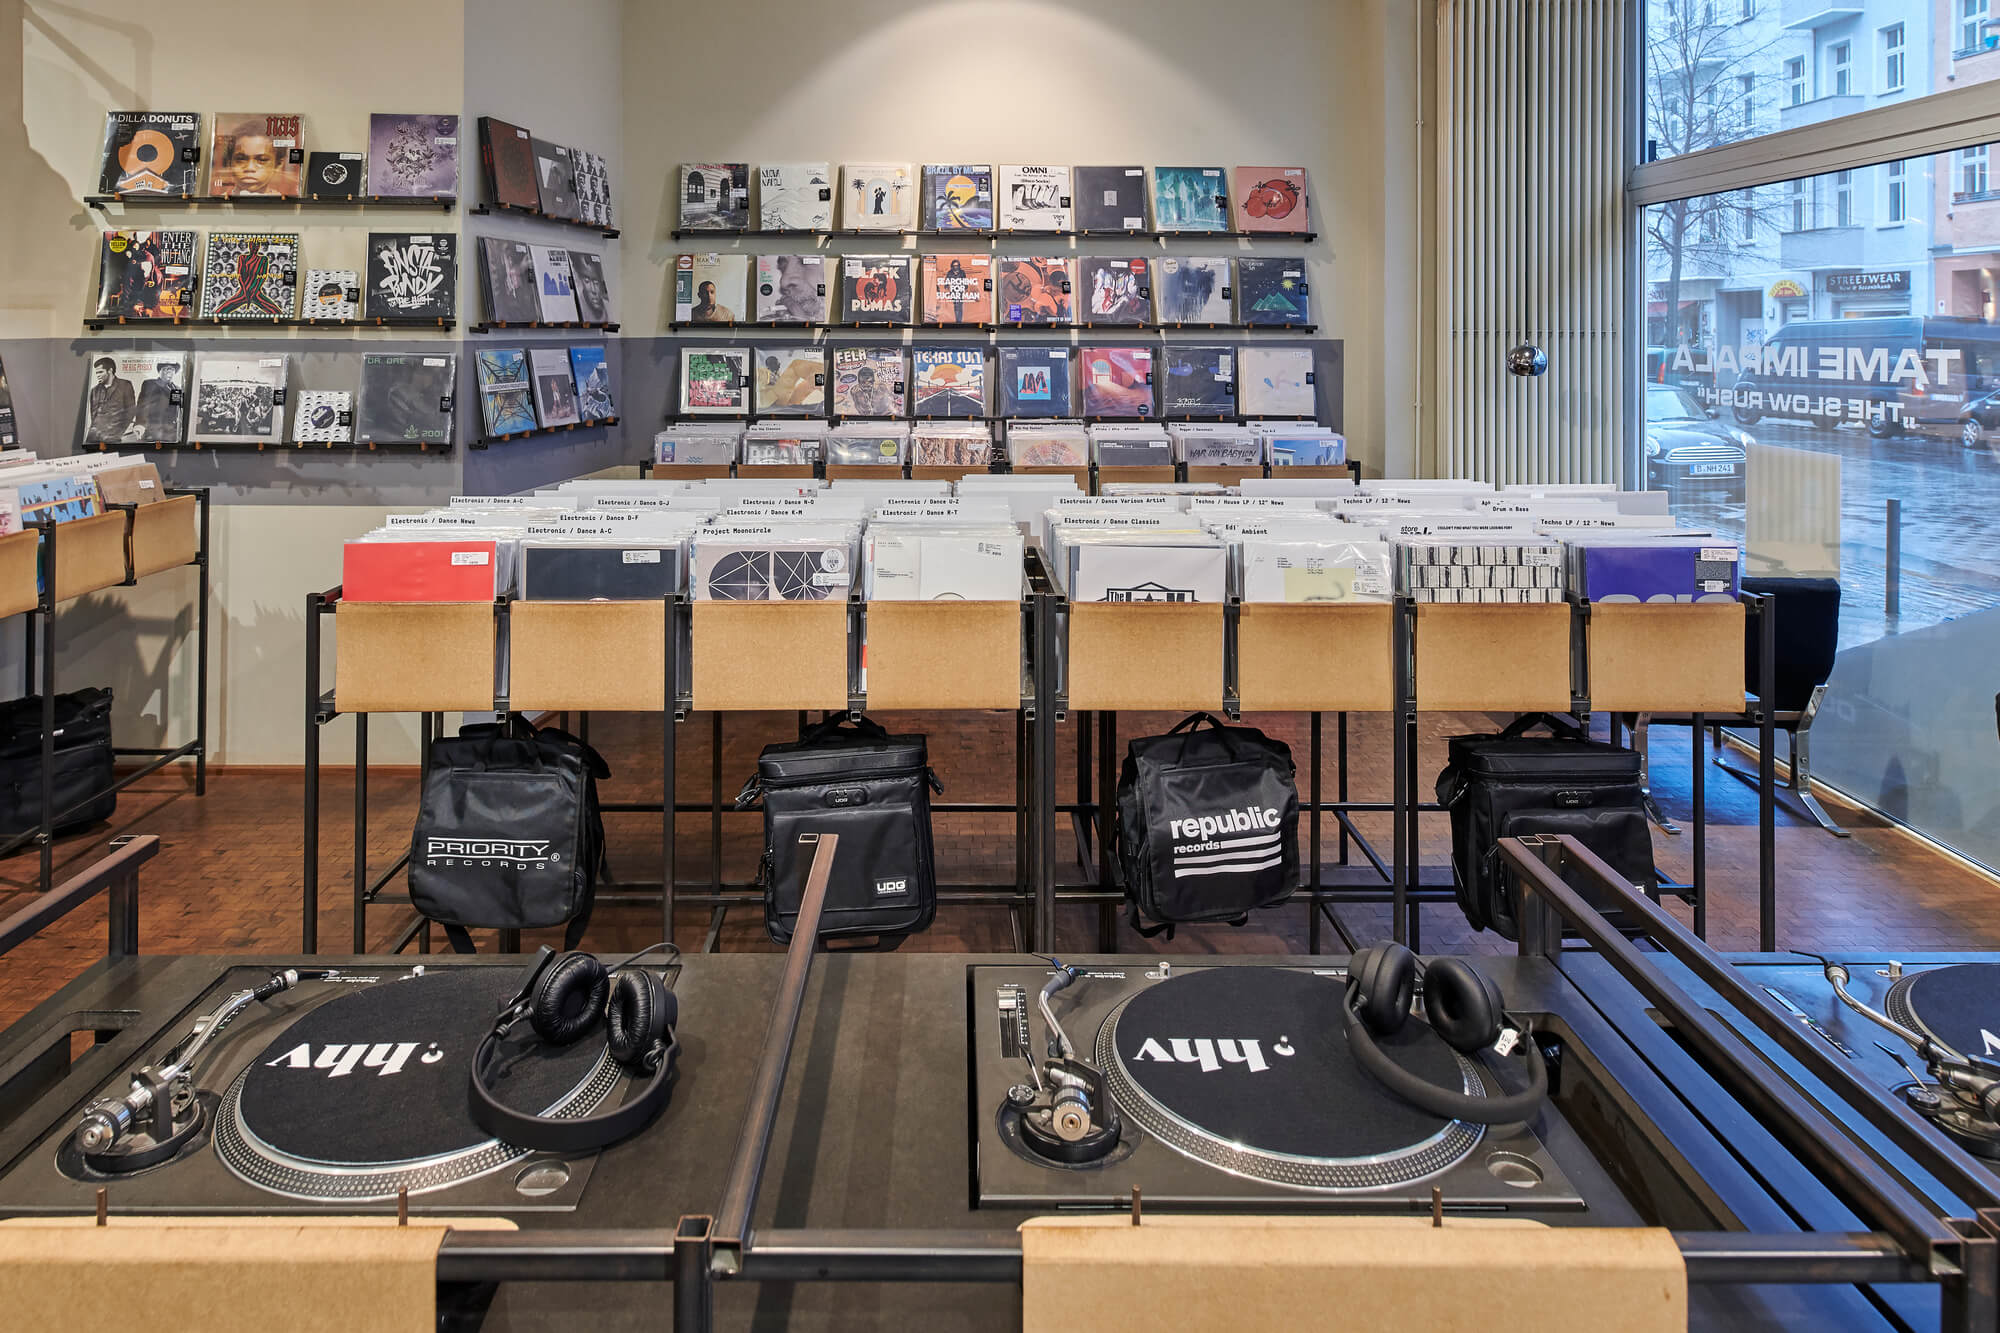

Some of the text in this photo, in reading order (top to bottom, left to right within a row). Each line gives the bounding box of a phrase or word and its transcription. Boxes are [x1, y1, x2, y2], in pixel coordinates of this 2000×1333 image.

[118, 114, 146, 122] DILLA
[148, 115, 192, 123] DONUTS
[953, 166, 962, 174] BY
[162, 232, 192, 242] ENTER
[1830, 272, 1901, 286] STREETWEAR
[852, 300, 902, 312] PUMAS
[836, 350, 866, 362] FELA
[916, 352, 953, 364] TEXAS
[957, 352, 981, 364] SUN
[1170, 806, 1280, 840] republic
[428, 842, 550, 856] PRIORITY
[1174, 841, 1220, 854] records
[427, 860, 545, 870] RECORDS
[876, 880, 906, 892] UDG
